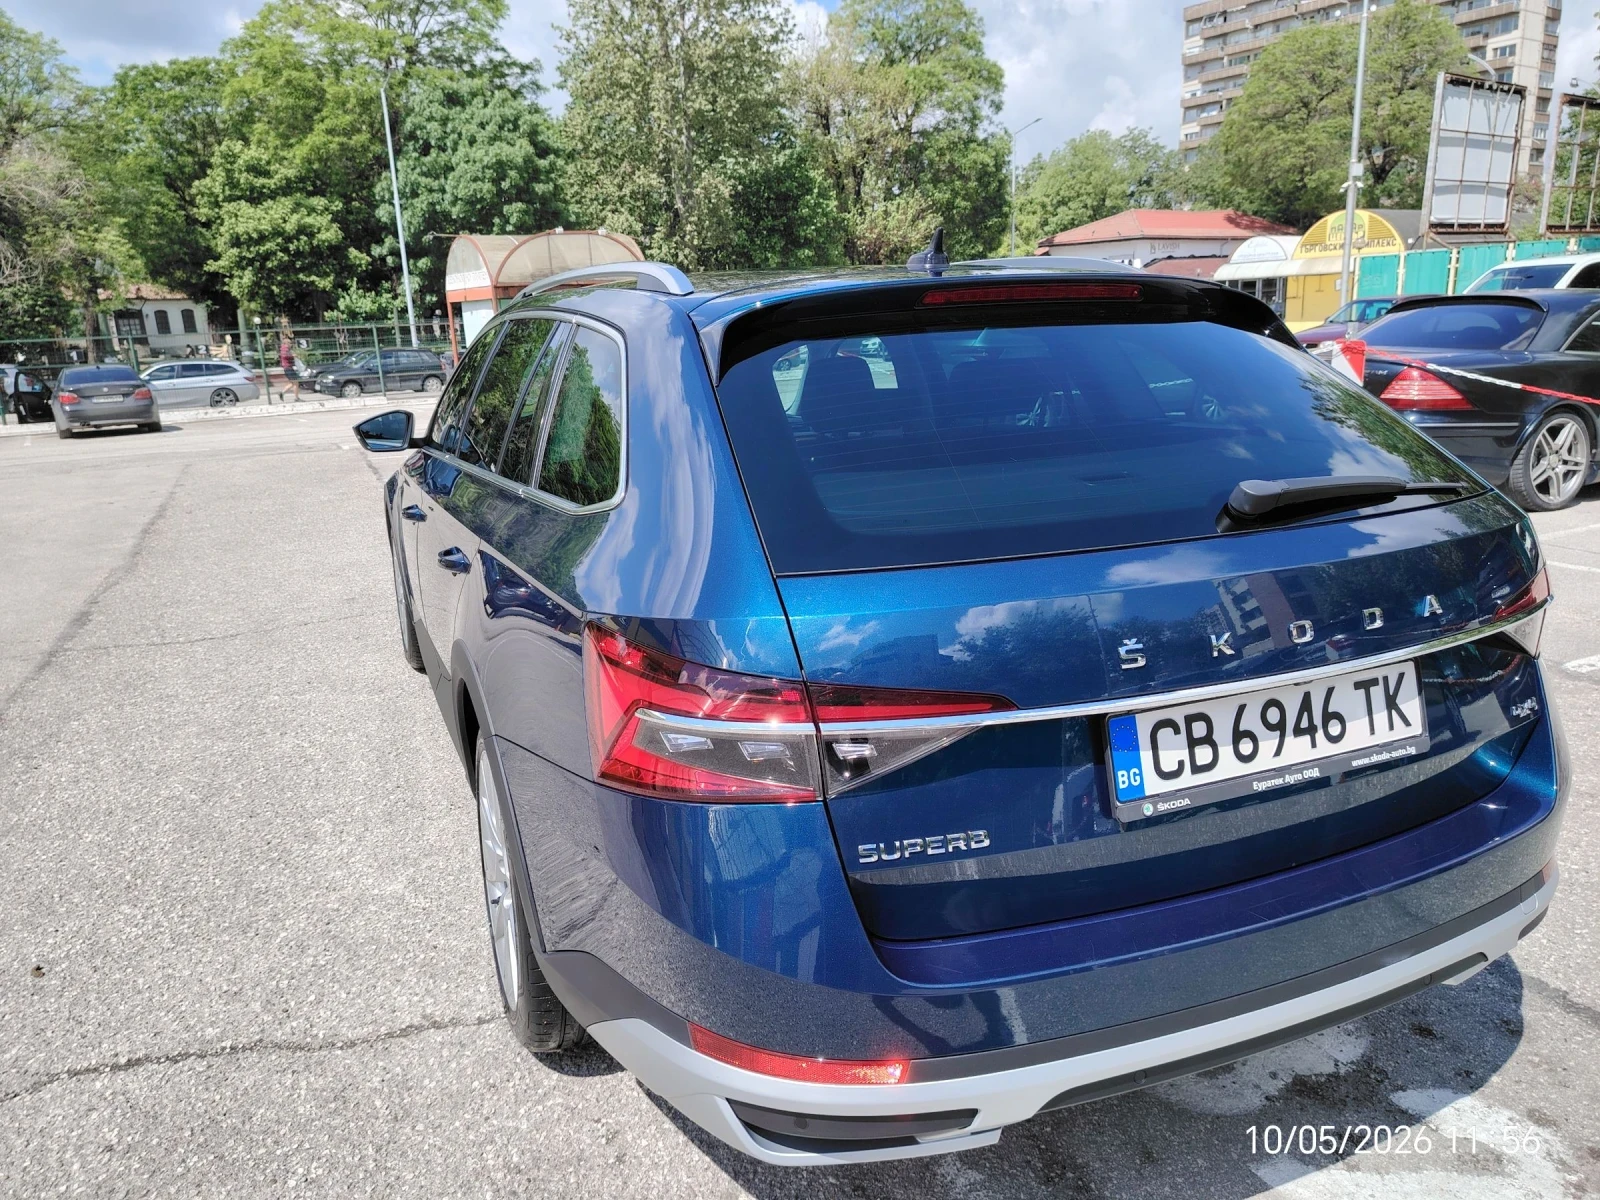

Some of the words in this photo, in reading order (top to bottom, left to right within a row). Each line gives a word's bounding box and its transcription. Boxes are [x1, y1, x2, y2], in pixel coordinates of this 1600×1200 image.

[1118, 594, 1443, 670] ŠKODA
[1232, 686, 1347, 764] 6946
[1351, 745, 1416, 767] www.skoda-auto.bg
[1117, 767, 1141, 789] BG
[1252, 777, 1284, 792] Еуратек
[1285, 773, 1302, 784] Ауто
[1303, 767, 1320, 779] ООД
[1157, 797, 1191, 812] ŠKODA
[858, 829, 991, 864] SUPERB
